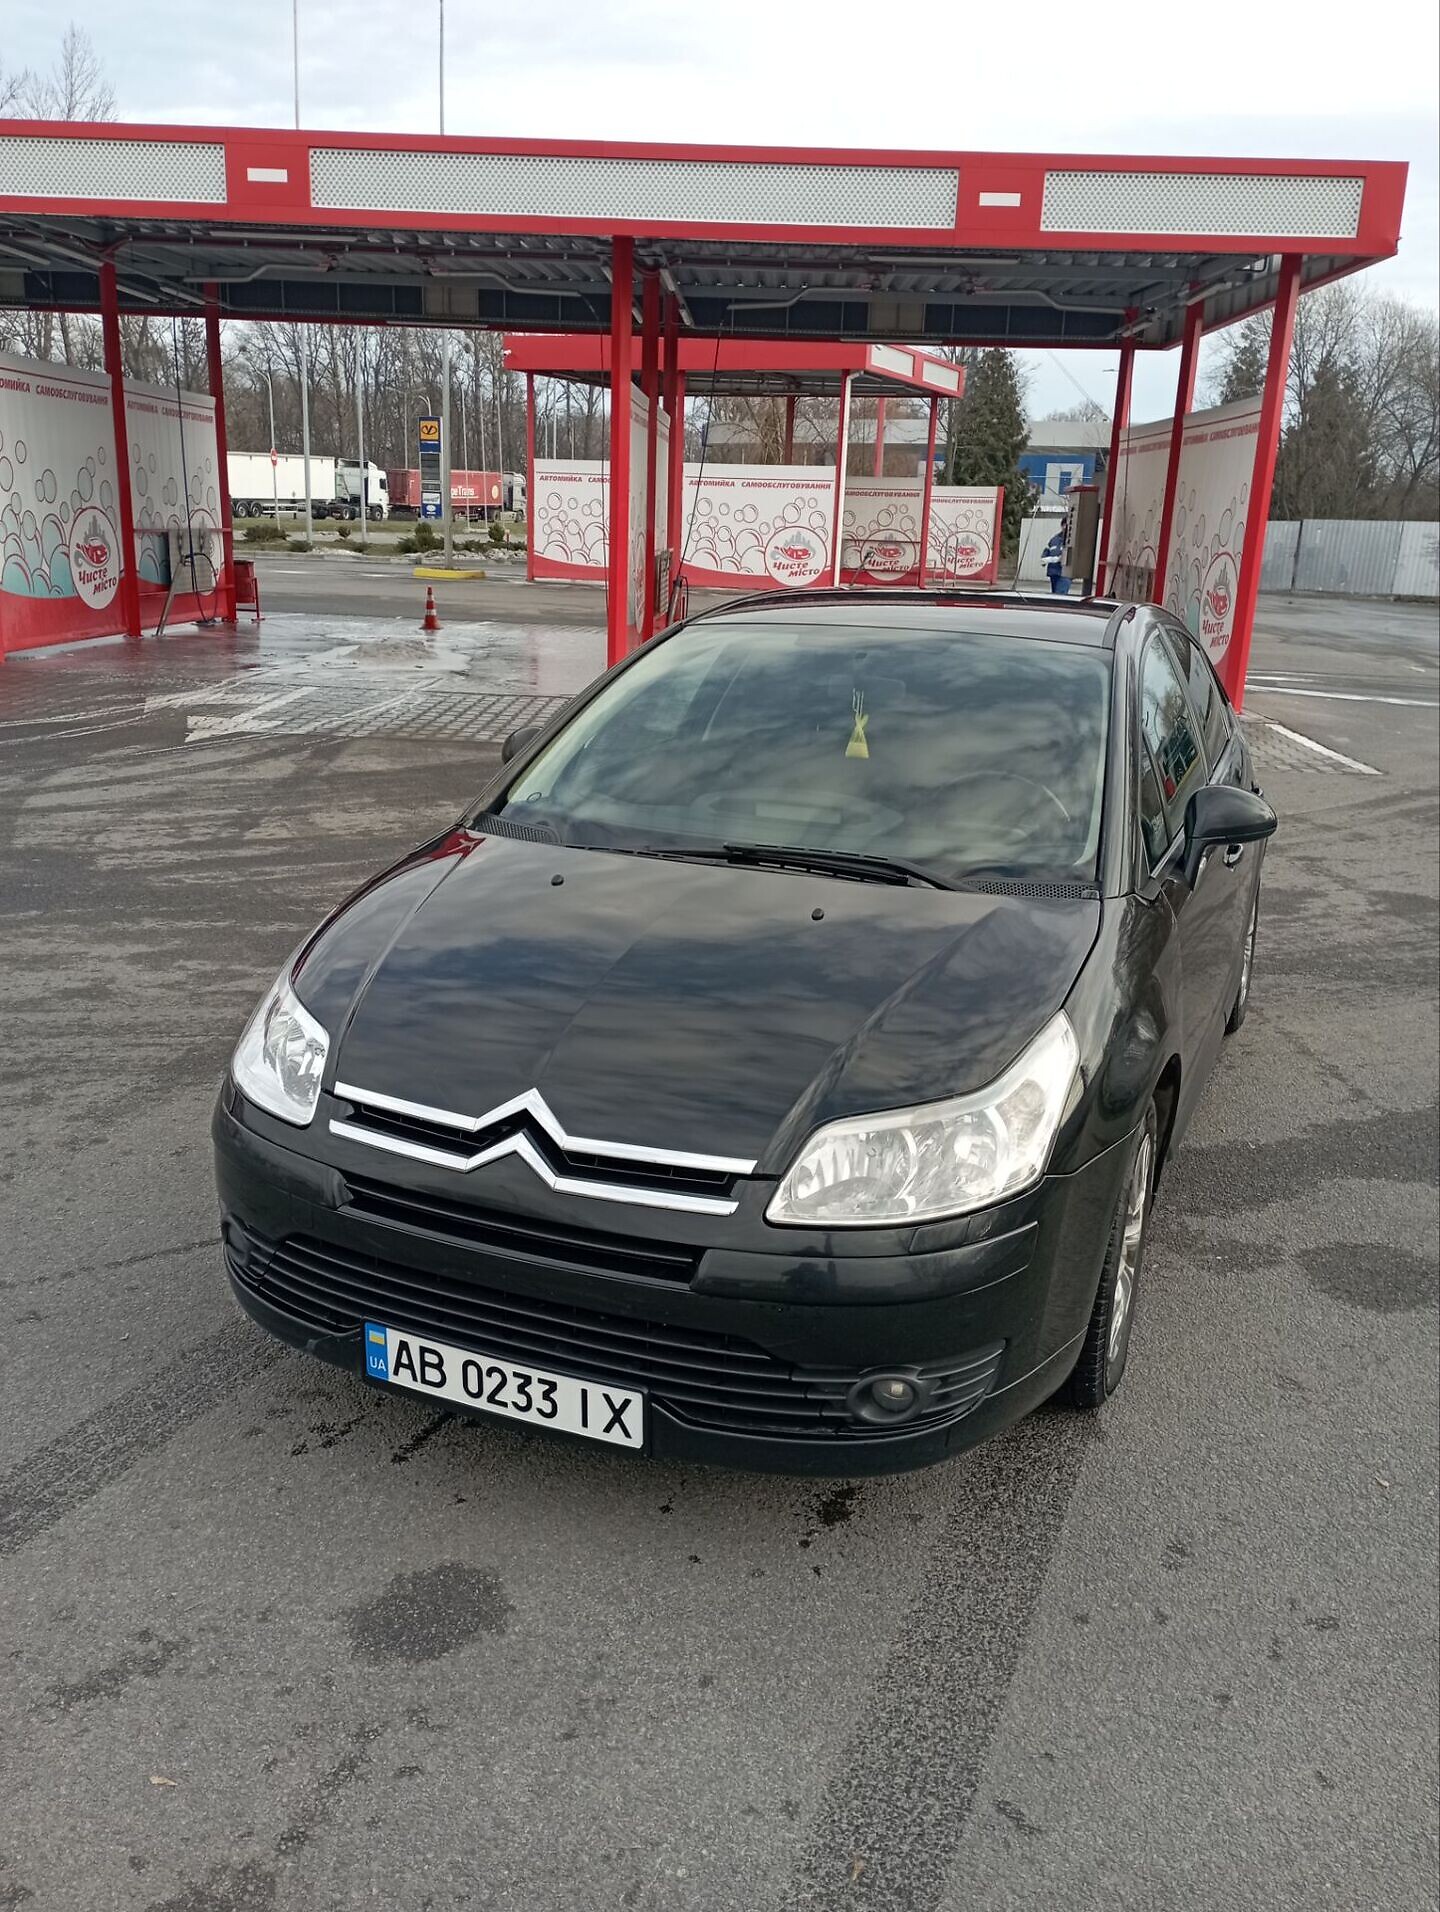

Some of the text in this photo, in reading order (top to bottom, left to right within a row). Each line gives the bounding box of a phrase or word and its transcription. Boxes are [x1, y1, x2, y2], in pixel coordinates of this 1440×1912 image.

[689, 480, 831, 490] АВТОМИЙКА САМООБСЛУГОВУВАННЯ
[773, 561, 809, 571] Чисте
[788, 567, 820, 578] місто
[78, 567, 108, 585] Чисте
[93, 576, 118, 595] місто
[1202, 619, 1225, 635] Чисте
[369, 1356, 387, 1372] UA
[393, 1340, 447, 1389] AB
[462, 1359, 558, 1419] 0233
